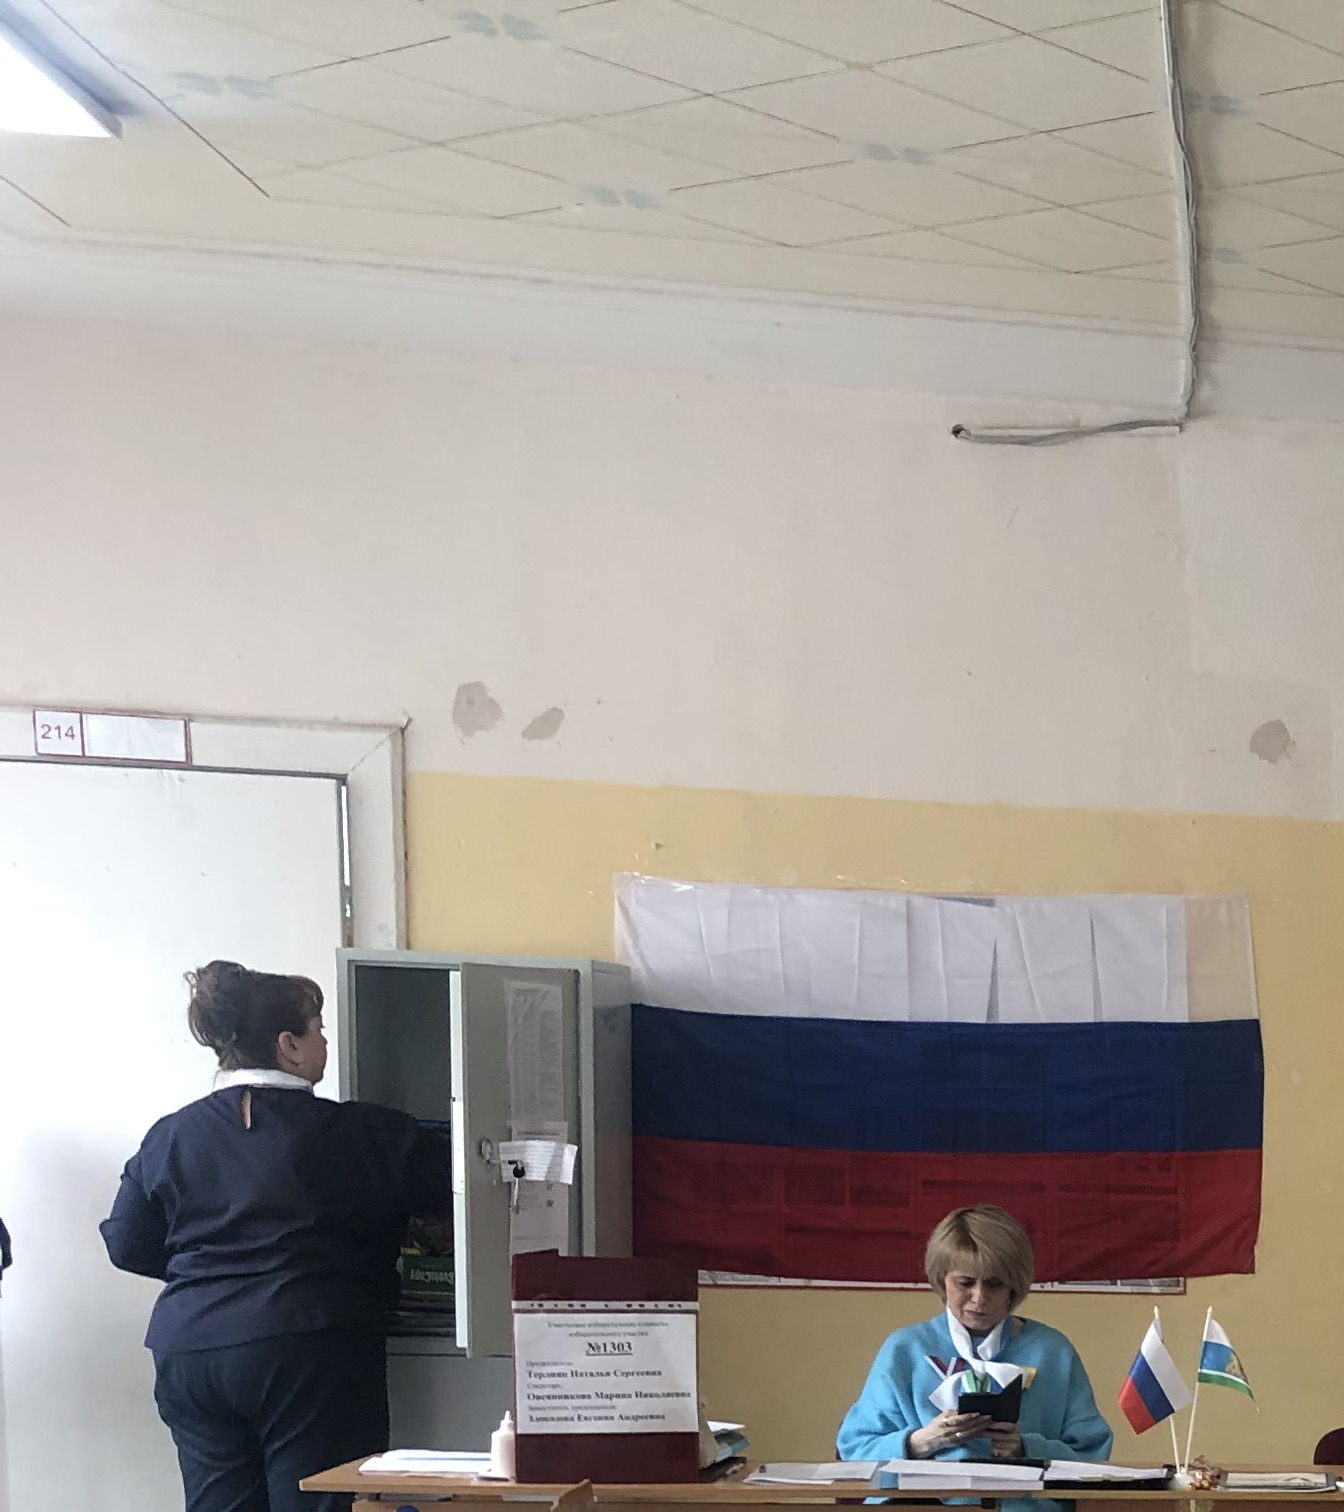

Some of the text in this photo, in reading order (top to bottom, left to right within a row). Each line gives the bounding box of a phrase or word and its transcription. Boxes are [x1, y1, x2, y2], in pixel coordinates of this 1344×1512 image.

[40, 723, 76, 740] 214
[586, 1341, 633, 1355] №1303
[570, 1369, 611, 1378] Наталья
[613, 1368, 662, 1379] Сергеевна
[634, 1390, 691, 1399] Николаевна
[617, 1412, 666, 1423] Андреевна
